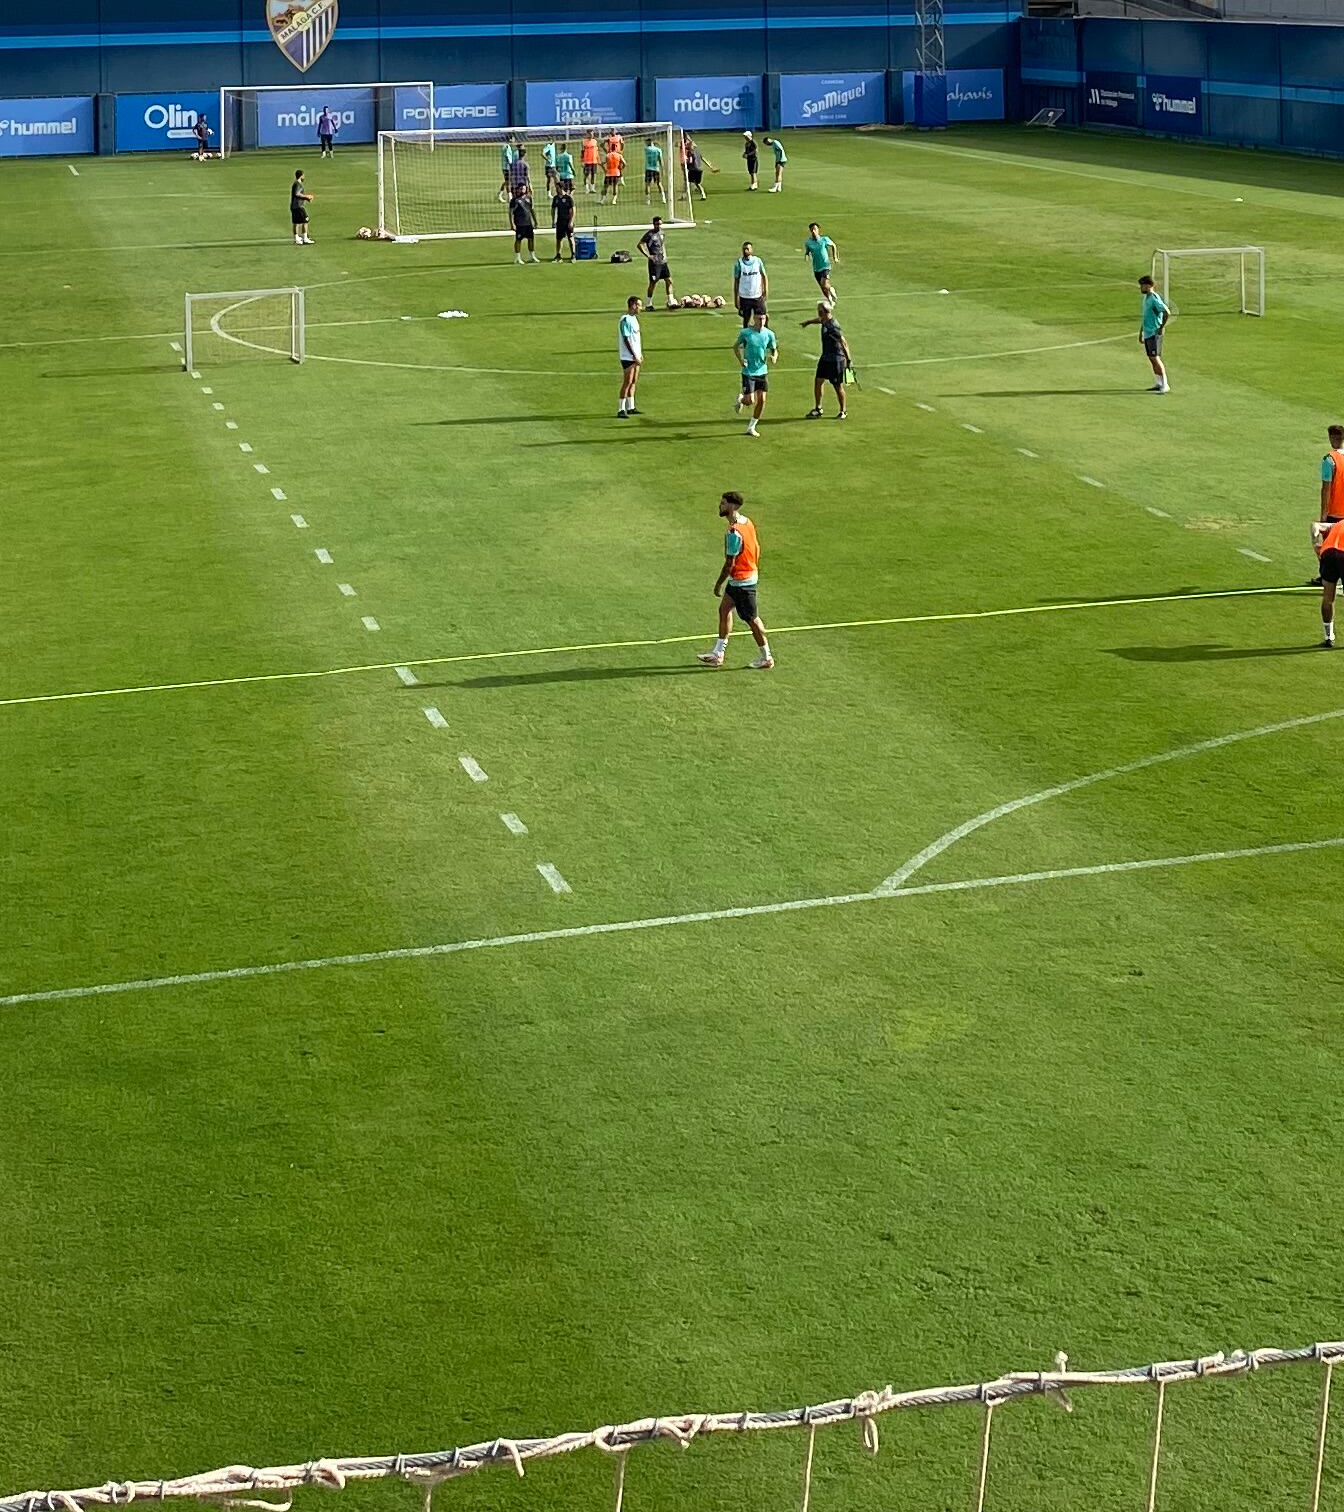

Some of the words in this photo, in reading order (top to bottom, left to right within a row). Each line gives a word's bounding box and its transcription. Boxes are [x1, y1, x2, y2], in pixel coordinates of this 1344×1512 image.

[144, 104, 198, 129] Olin
[402, 105, 499, 120] POWERADE
[10, 117, 76, 136] hummel
